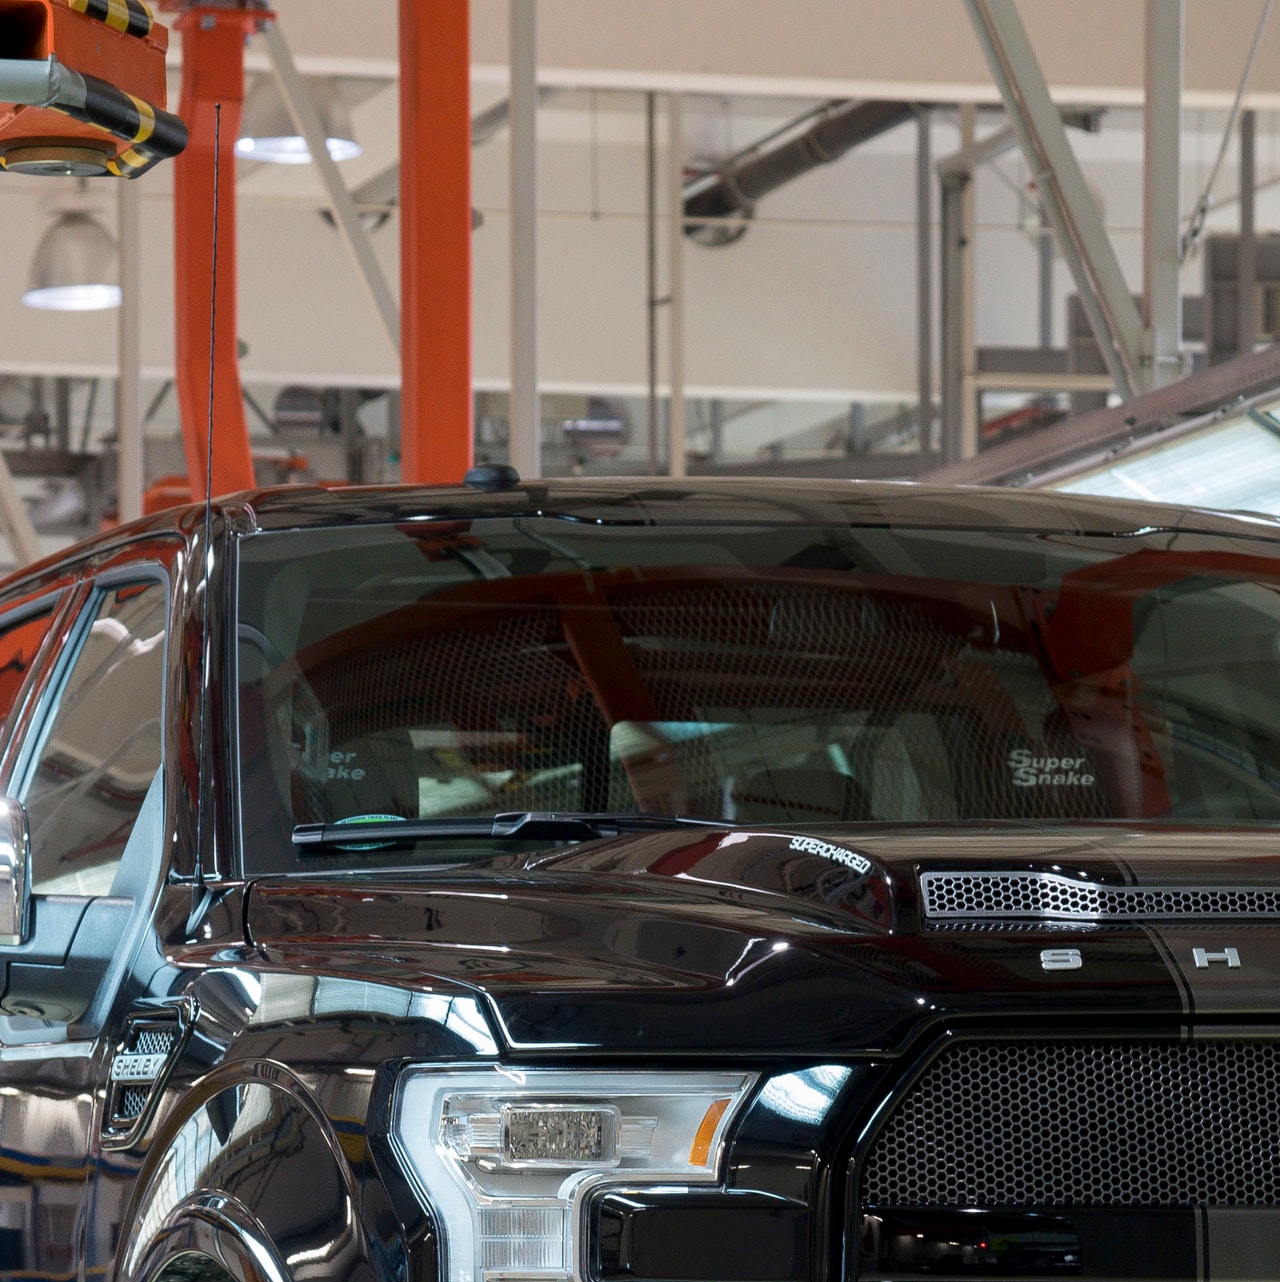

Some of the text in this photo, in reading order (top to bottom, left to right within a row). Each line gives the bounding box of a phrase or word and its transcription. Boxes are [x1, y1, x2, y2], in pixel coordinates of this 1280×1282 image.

[1007, 749, 1085, 772] Super
[1012, 767, 1095, 786] Snake
[788, 835, 872, 875] SUPERCHARGED
[114, 1057, 160, 1077] SHELBY
